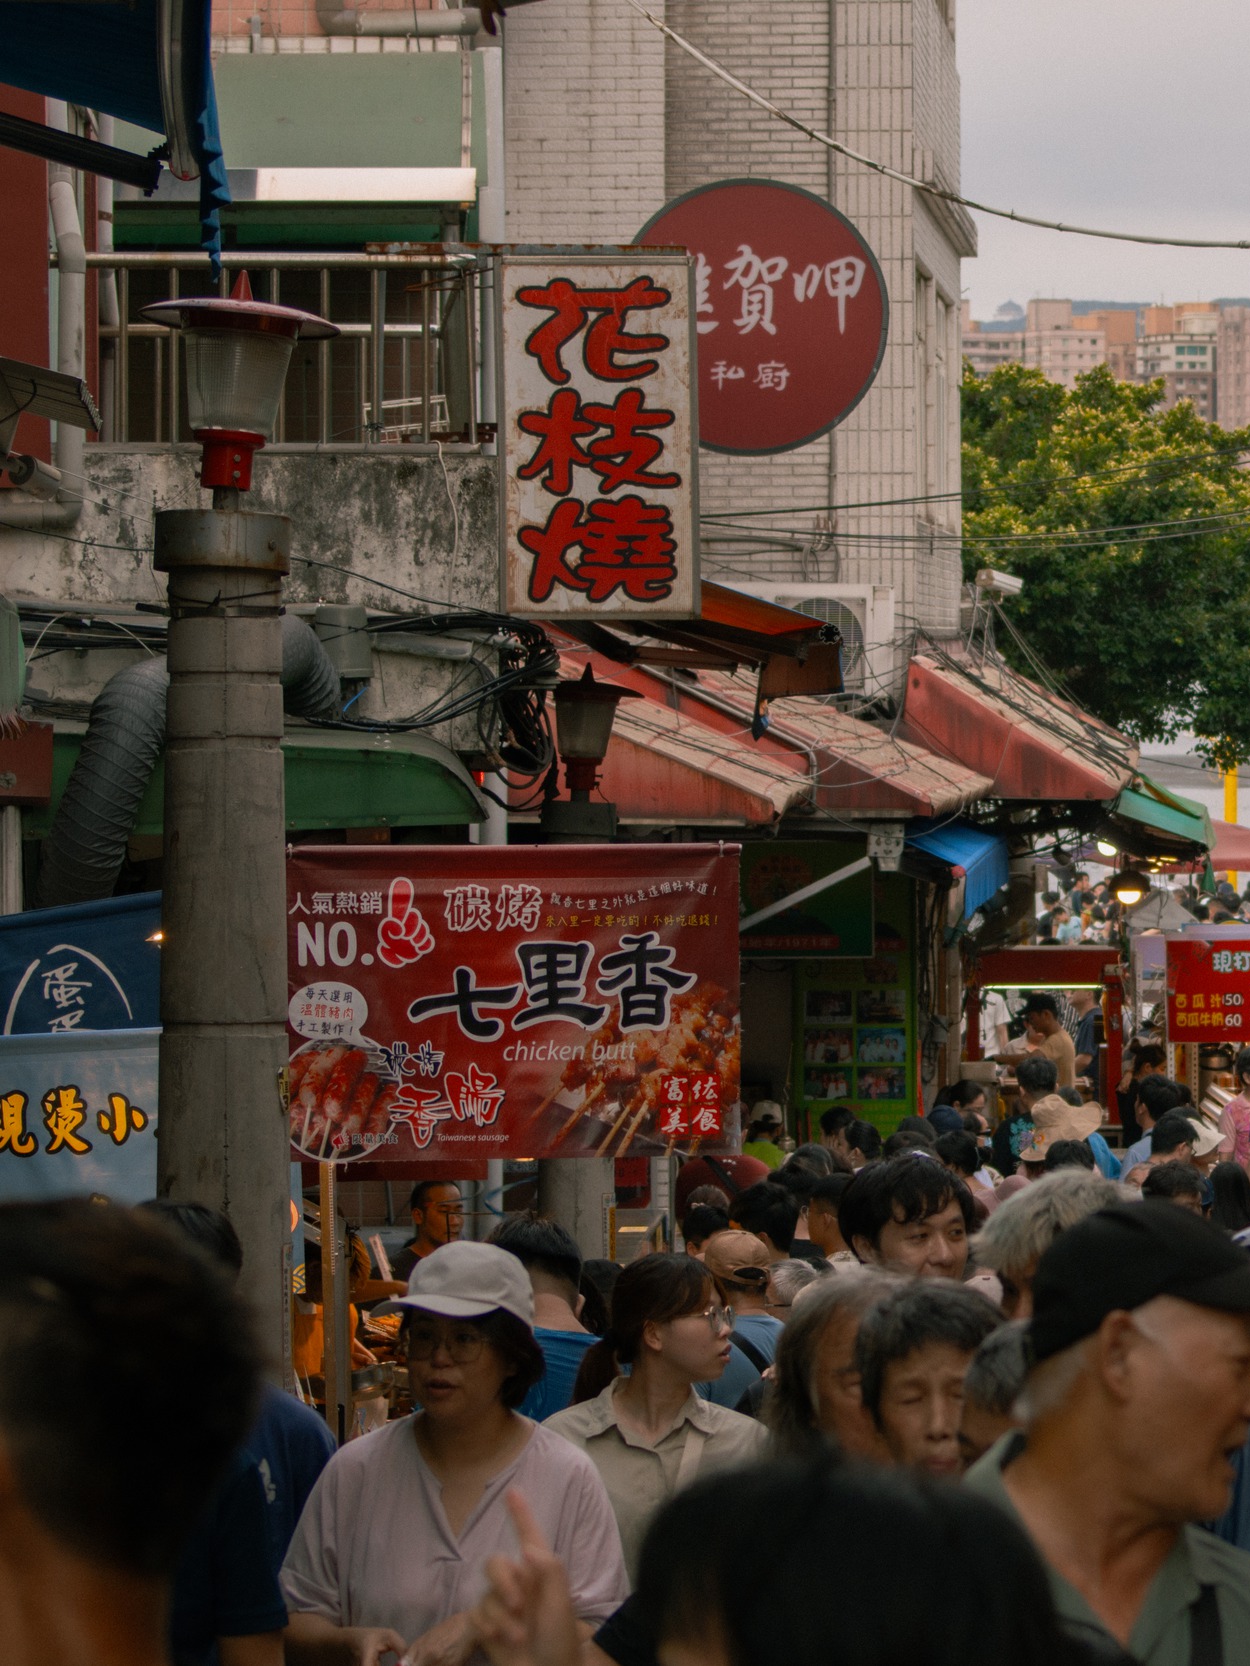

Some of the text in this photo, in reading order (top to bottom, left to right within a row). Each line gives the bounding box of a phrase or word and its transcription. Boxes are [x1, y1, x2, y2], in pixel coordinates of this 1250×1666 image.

[709, 360, 791, 391] 私廚
[515, 276, 682, 602] 花枝燒
[288, 891, 383, 915] 人氣熱銷
[443, 884, 544, 932] 碳烤
[297, 921, 375, 967] NO.
[306, 988, 353, 1003] 每天選用
[407, 931, 697, 1042] 七里香
[301, 1004, 353, 1020] 溫體豬肉
[1175, 994, 1222, 1009] 西瓜汁
[1176, 1013, 1242, 1027] 西瓜牛奶 60
[502, 1040, 638, 1061] chicken butt
[661, 1106, 720, 1132] 美食
[437, 1133, 510, 1143] Taiwanese sausage
